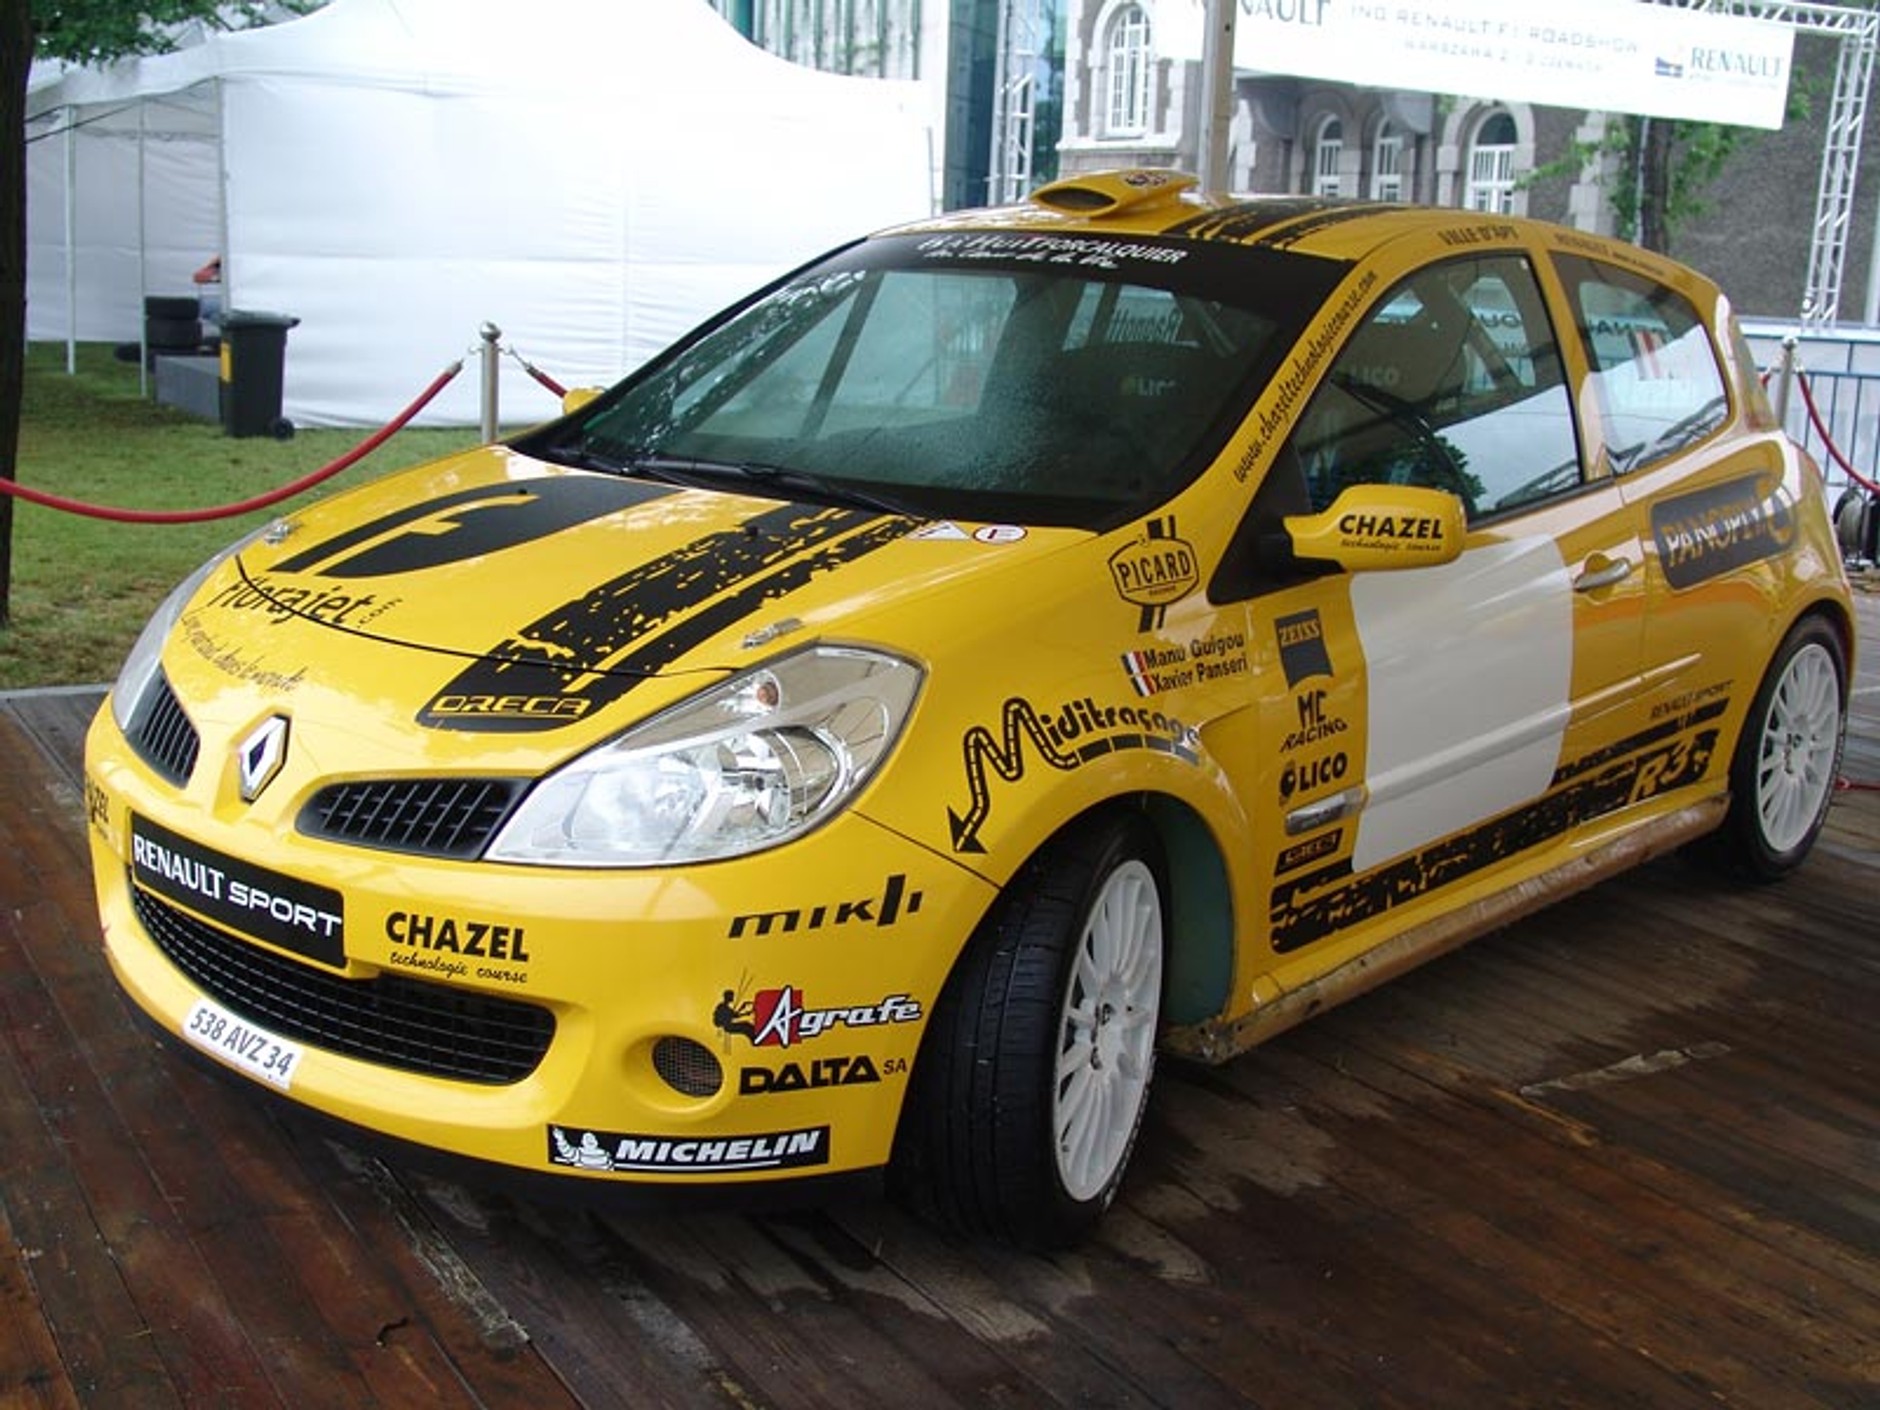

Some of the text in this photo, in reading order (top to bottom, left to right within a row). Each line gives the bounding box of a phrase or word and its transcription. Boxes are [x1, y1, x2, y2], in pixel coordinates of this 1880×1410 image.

[1397, 8, 1490, 34] RENAULT
[1690, 46, 1784, 77] RENAULT
[1437, 226, 1480, 247] VILLE
[1338, 514, 1443, 540] CHAZEL
[1116, 549, 1191, 588] PICARD
[1278, 618, 1320, 647] ZEISS
[1144, 634, 1245, 669] Manu Guigou
[1151, 652, 1248, 693] Xavier Panseri
[432, 694, 593, 716] ORECA
[1297, 689, 1328, 729] MC
[1279, 719, 1349, 754] RACING
[133, 833, 343, 937] RENAULT SPORT
[385, 911, 530, 963] CHAZEL
[389, 951, 529, 984] technologie course
[753, 985, 923, 1048] Agrafe
[189, 1008, 295, 1077] 538 AVZ 34
[738, 1055, 908, 1096] DALTA SA
[615, 1129, 823, 1164] MICHELIN
